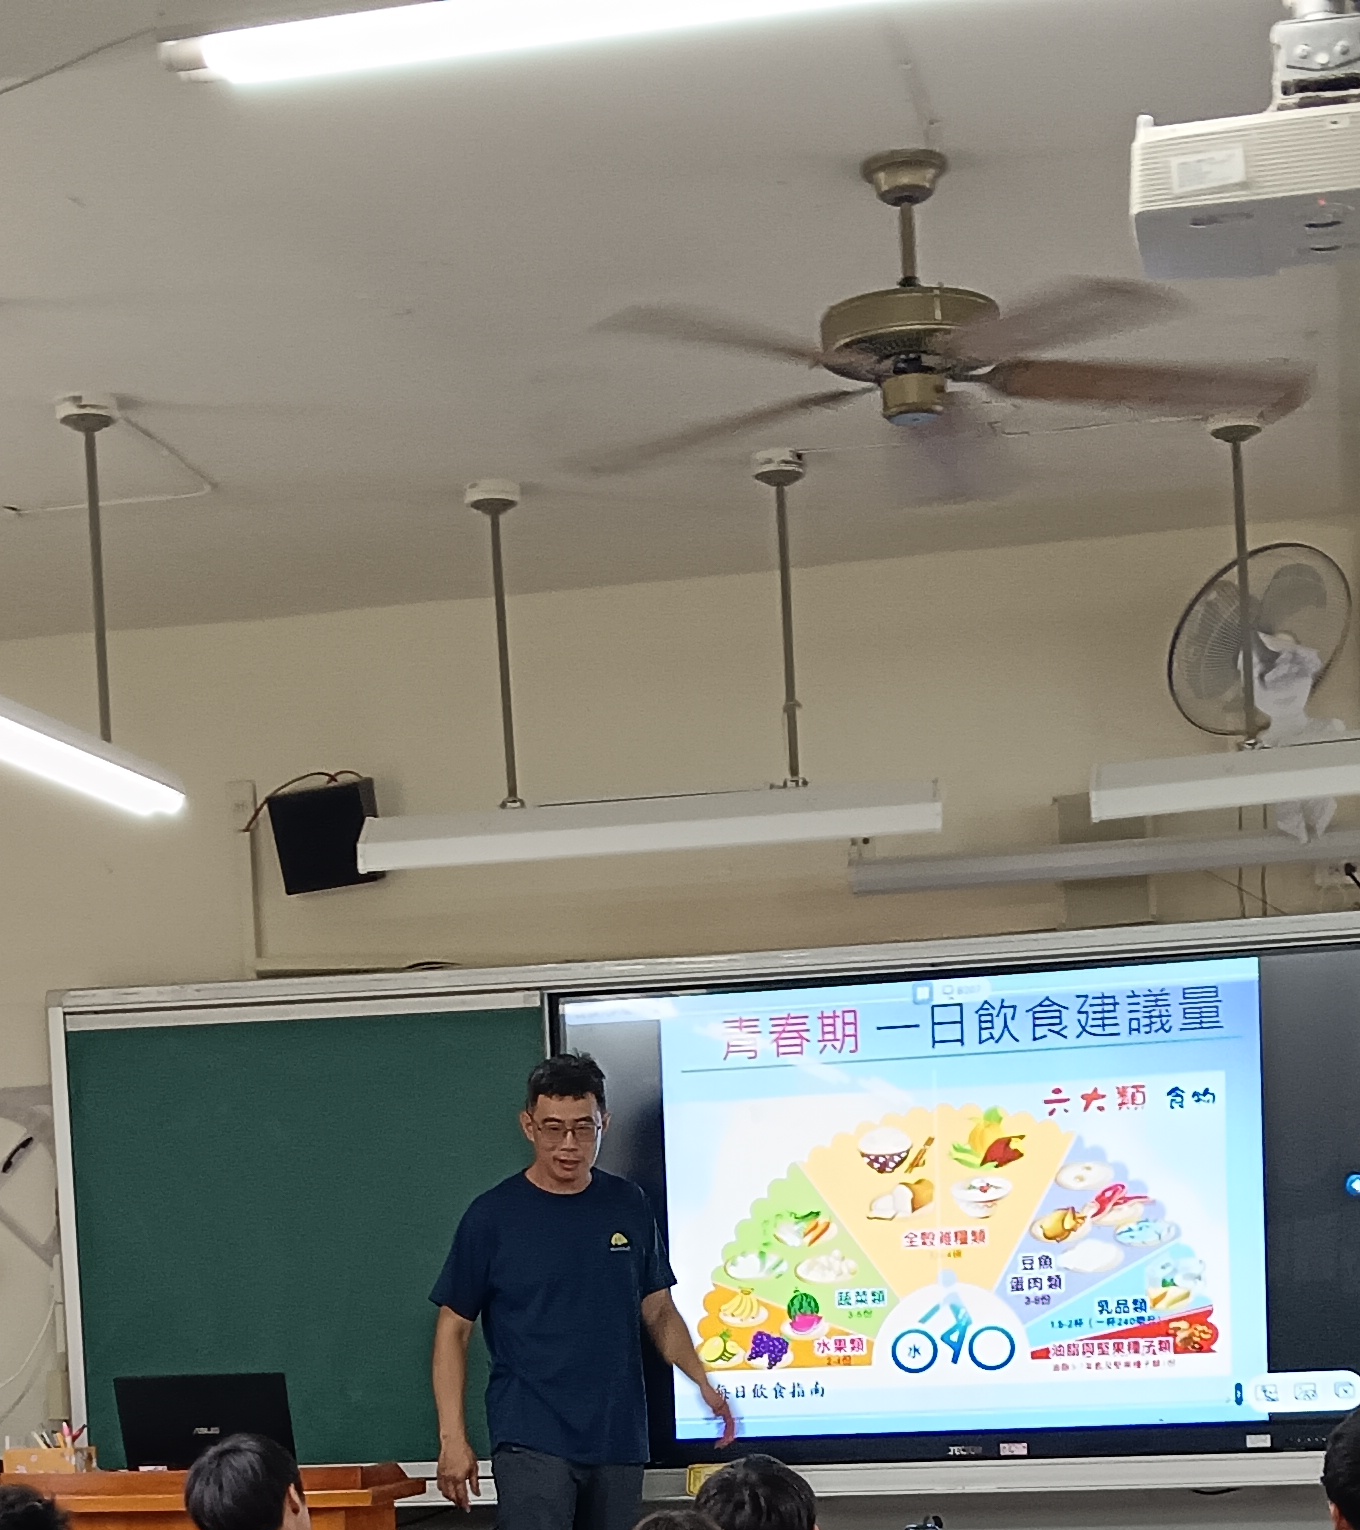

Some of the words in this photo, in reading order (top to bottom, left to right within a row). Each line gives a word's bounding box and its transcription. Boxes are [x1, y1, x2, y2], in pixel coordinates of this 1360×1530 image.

[722, 1009, 859, 1061] 青春期
[875, 985, 1225, 1048] 一日飲食建議量
[1021, 1254, 1053, 1271] 豆魚
[1097, 1298, 1148, 1315] 乳品類
[817, 1337, 865, 1354] 水果類
[907, 1343, 921, 1358] 水
